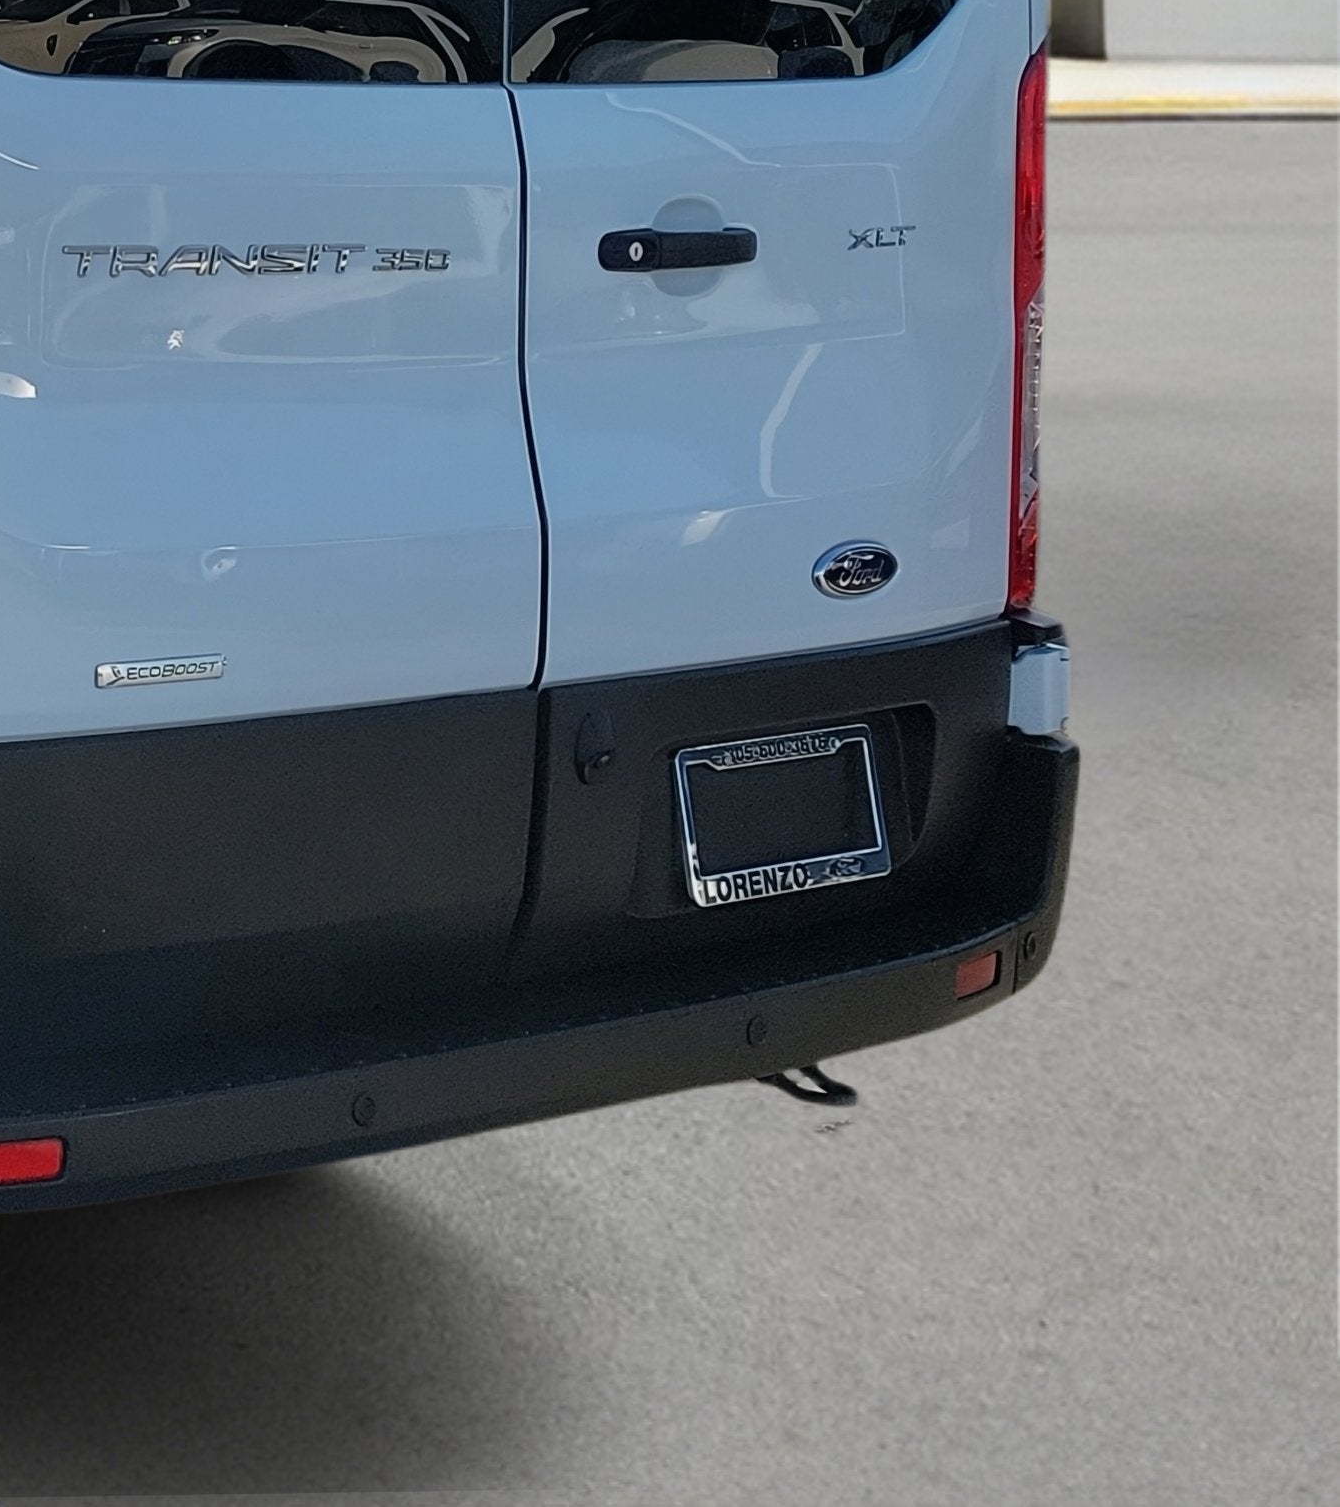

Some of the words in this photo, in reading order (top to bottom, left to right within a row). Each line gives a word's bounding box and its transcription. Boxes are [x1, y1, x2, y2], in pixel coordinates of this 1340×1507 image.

[847, 225, 916, 251] XLT
[62, 244, 367, 278] TRANSIT
[372, 247, 452, 273] 350
[839, 554, 885, 587] Ford
[126, 660, 220, 681] ECOBOOST
[704, 862, 809, 905] LORENZO
